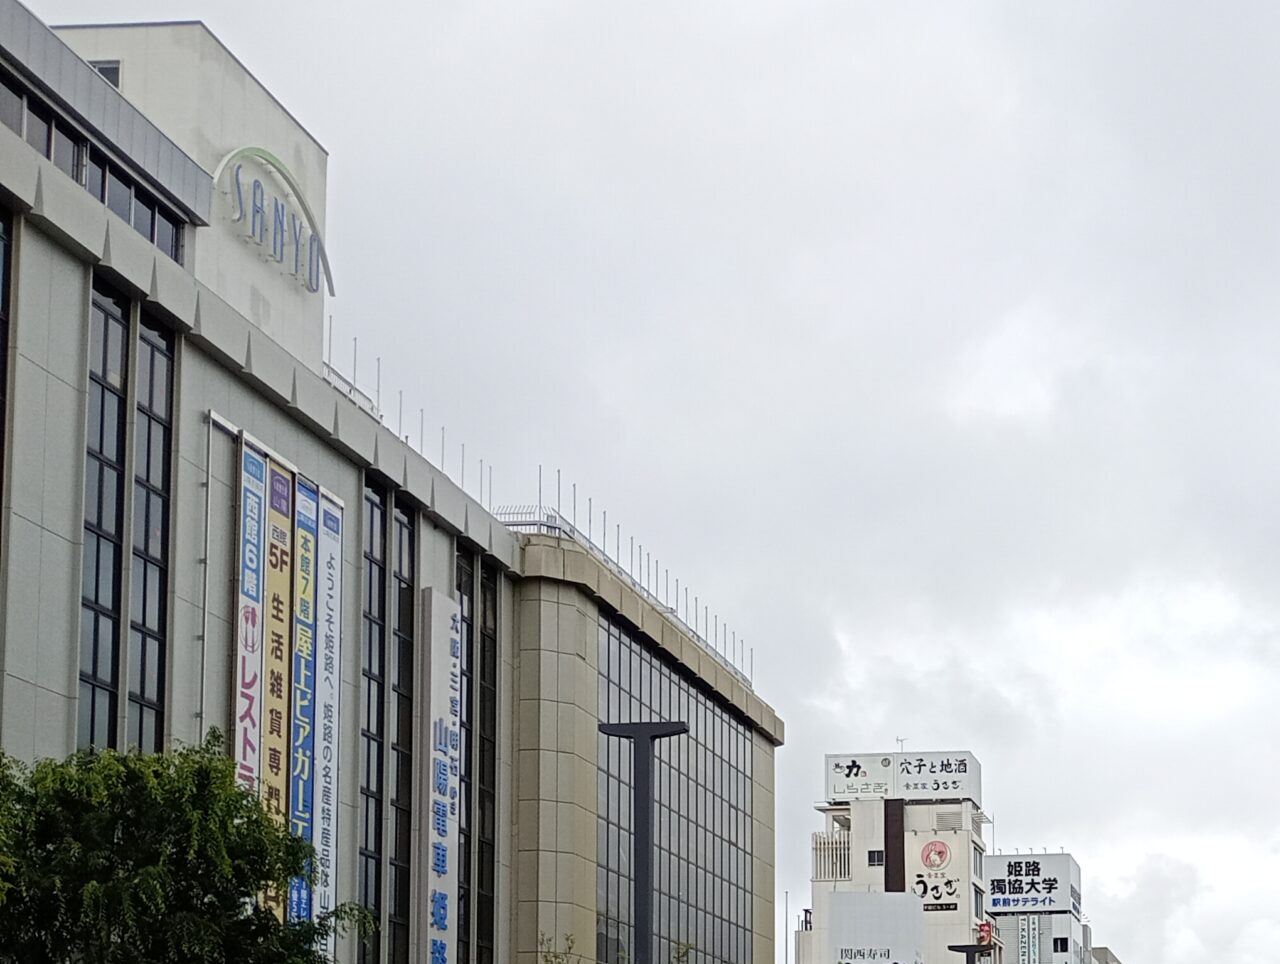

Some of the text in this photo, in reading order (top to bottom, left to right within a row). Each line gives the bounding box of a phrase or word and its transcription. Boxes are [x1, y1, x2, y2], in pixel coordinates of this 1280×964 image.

[231, 163, 321, 293] SANYO
[269, 542, 289, 573] 5F
[900, 758, 968, 775] 穴子と地酒
[432, 717, 450, 878] 山陽電車
[1007, 861, 1041, 877] 姫路
[912, 874, 960, 900] うさぎ
[990, 877, 1058, 895] 獨協大学
[991, 896, 1056, 907] 駅前サテライト
[840, 948, 891, 960] 関西寿司
